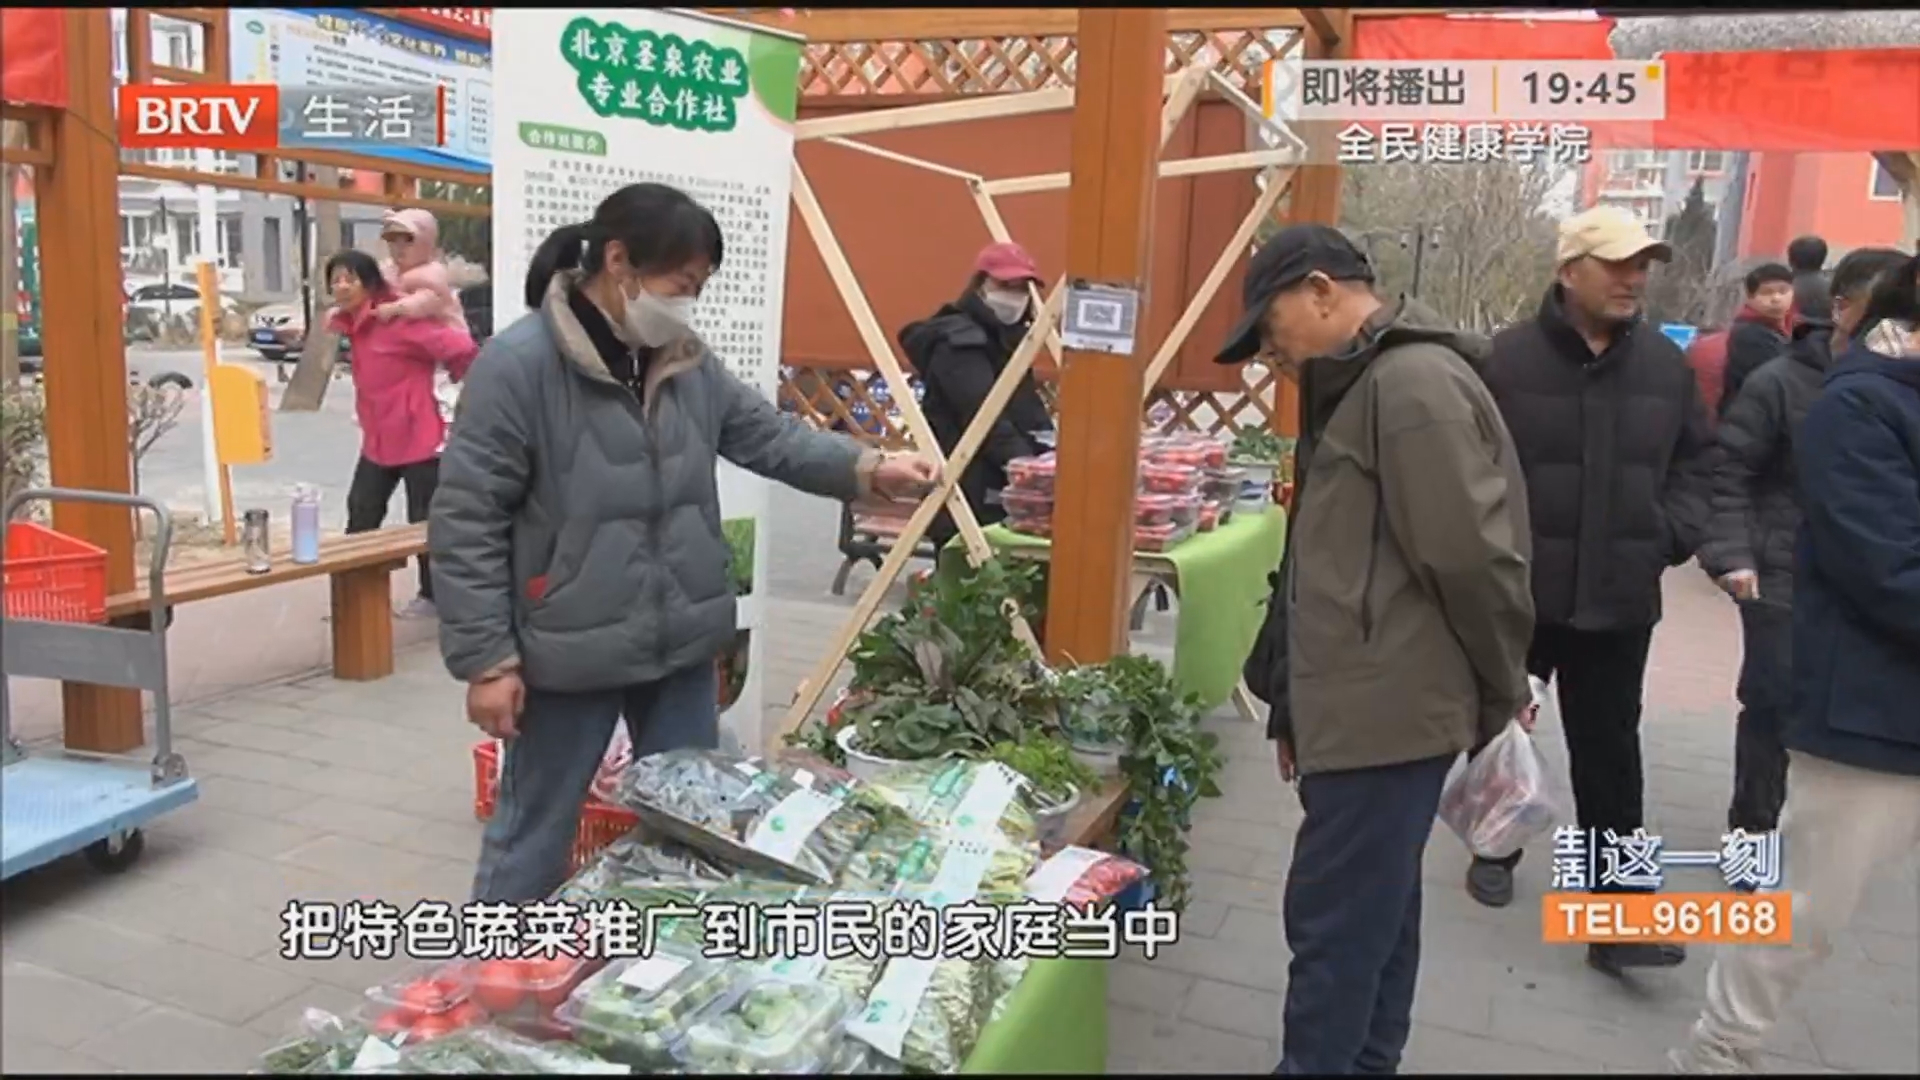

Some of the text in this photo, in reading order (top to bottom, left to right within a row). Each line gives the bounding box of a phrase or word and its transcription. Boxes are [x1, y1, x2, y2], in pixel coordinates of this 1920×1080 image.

[570, 28, 742, 87] 北京圣泉农业
[587, 71, 728, 123] 专业合作社
